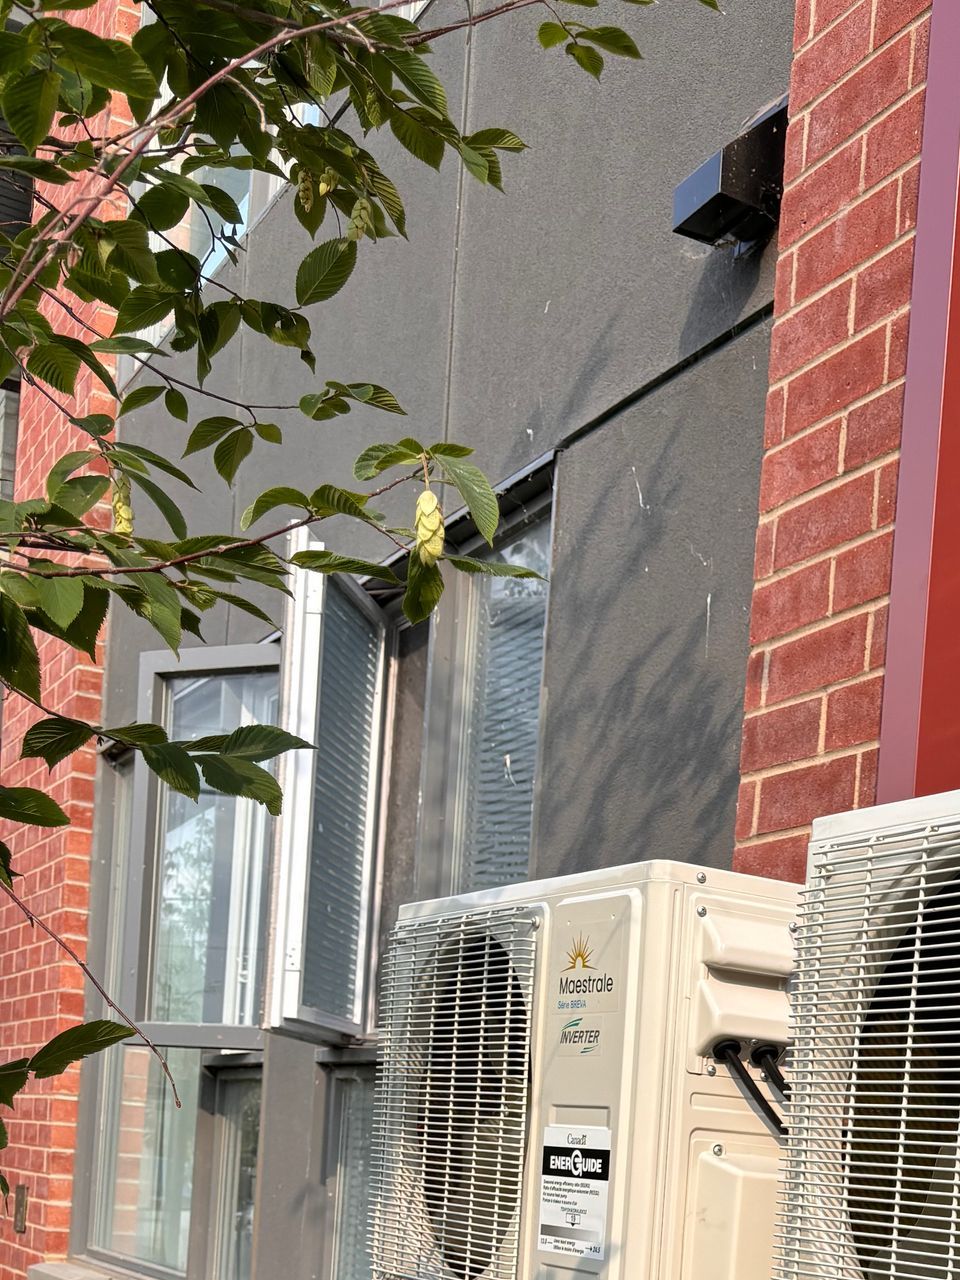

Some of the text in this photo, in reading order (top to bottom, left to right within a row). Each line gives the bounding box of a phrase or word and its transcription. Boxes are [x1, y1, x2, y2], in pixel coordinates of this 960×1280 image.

[559, 973, 614, 994] Maestrale
[560, 1030, 600, 1044] INVERTER
[567, 1133, 587, 1146] Canada
[550, 1149, 602, 1177] ENERGUIDE
